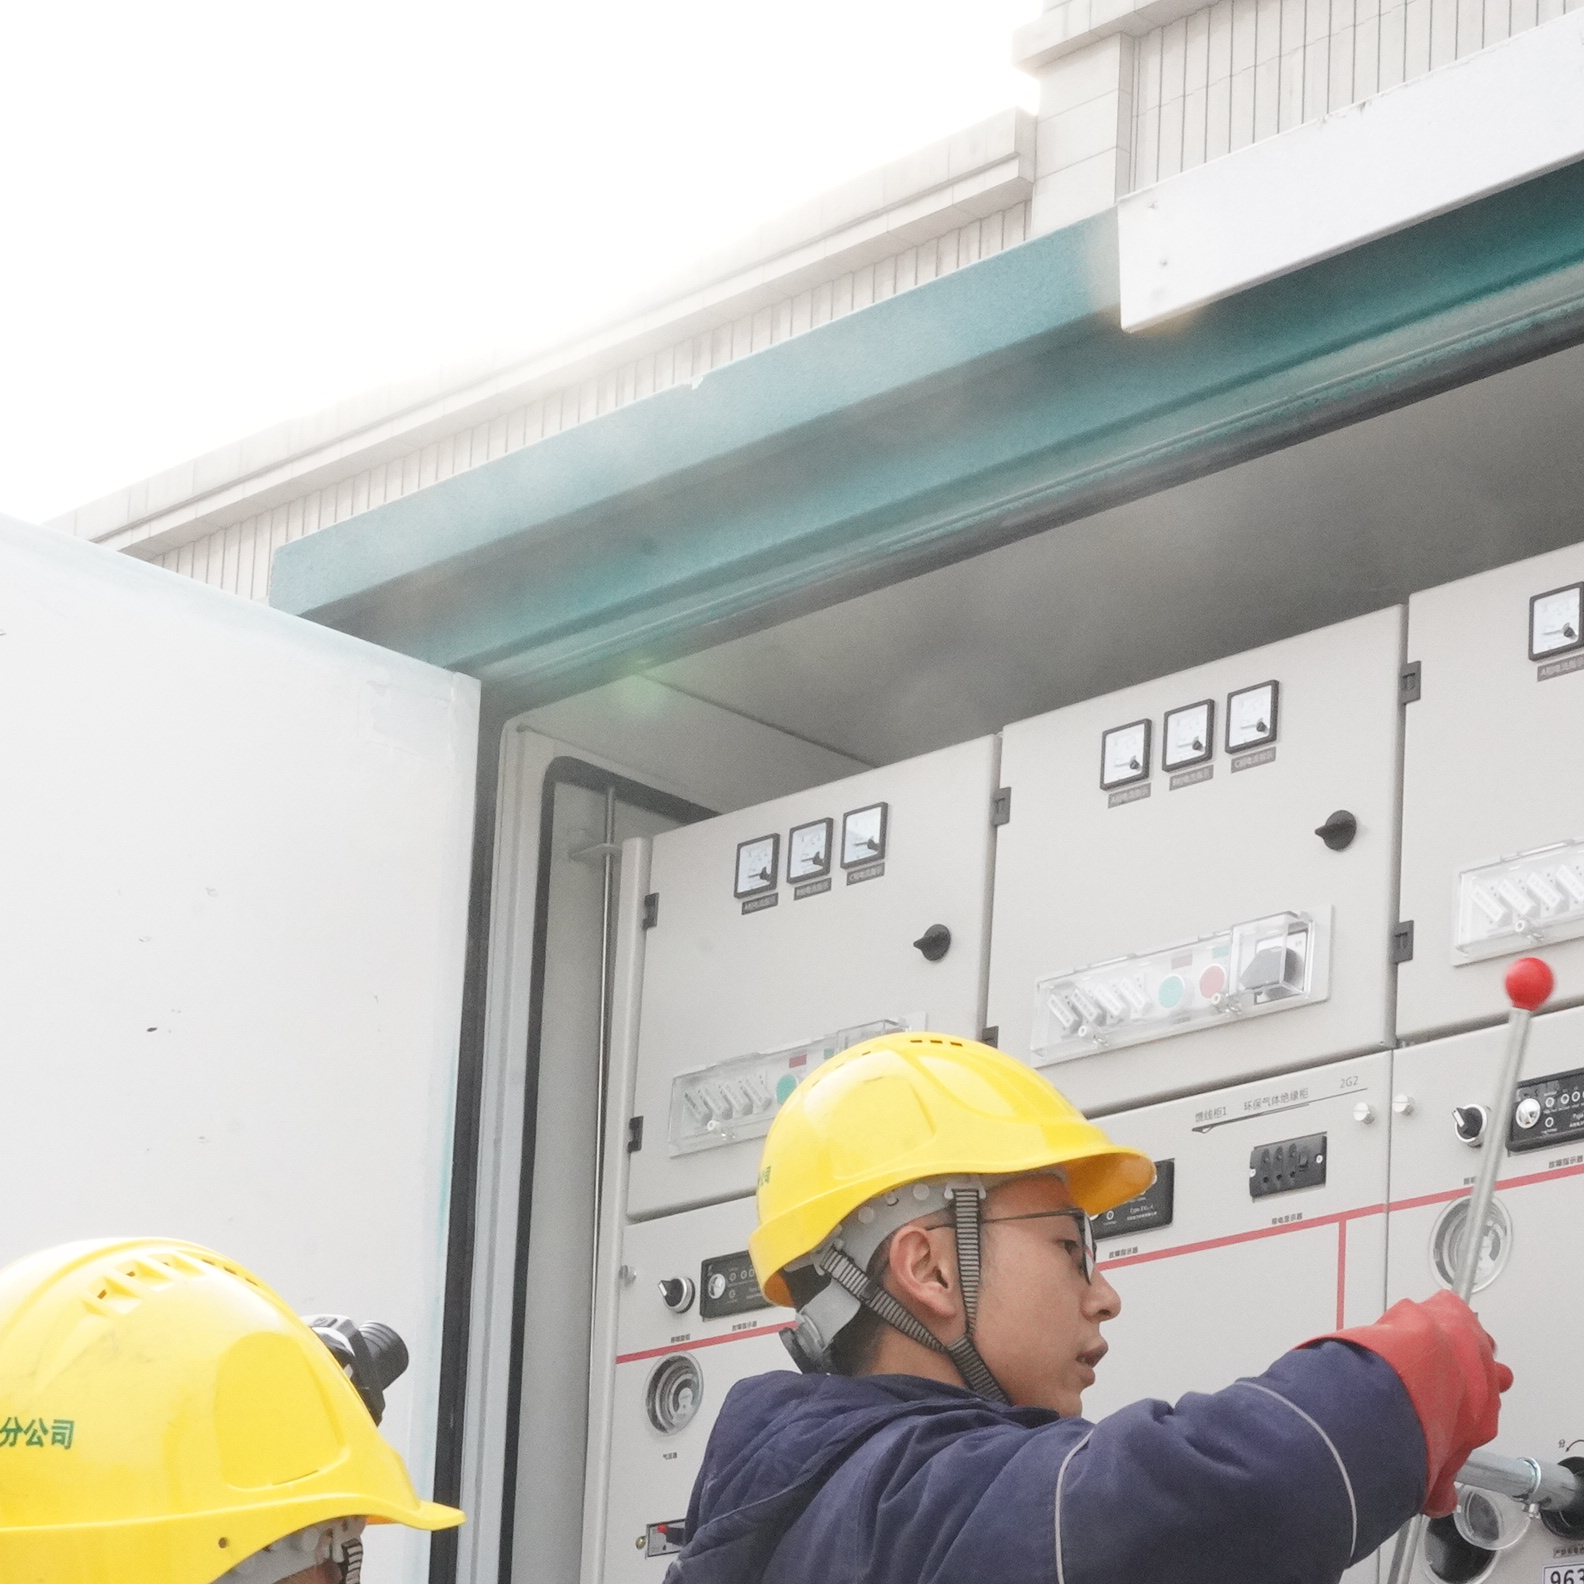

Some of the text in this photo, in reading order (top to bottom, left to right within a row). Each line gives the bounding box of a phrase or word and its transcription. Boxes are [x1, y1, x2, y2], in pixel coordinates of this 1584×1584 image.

[1244, 1088, 1309, 1112] 环保气体绝缘柜
[1340, 1076, 1359, 1089] 2G2
